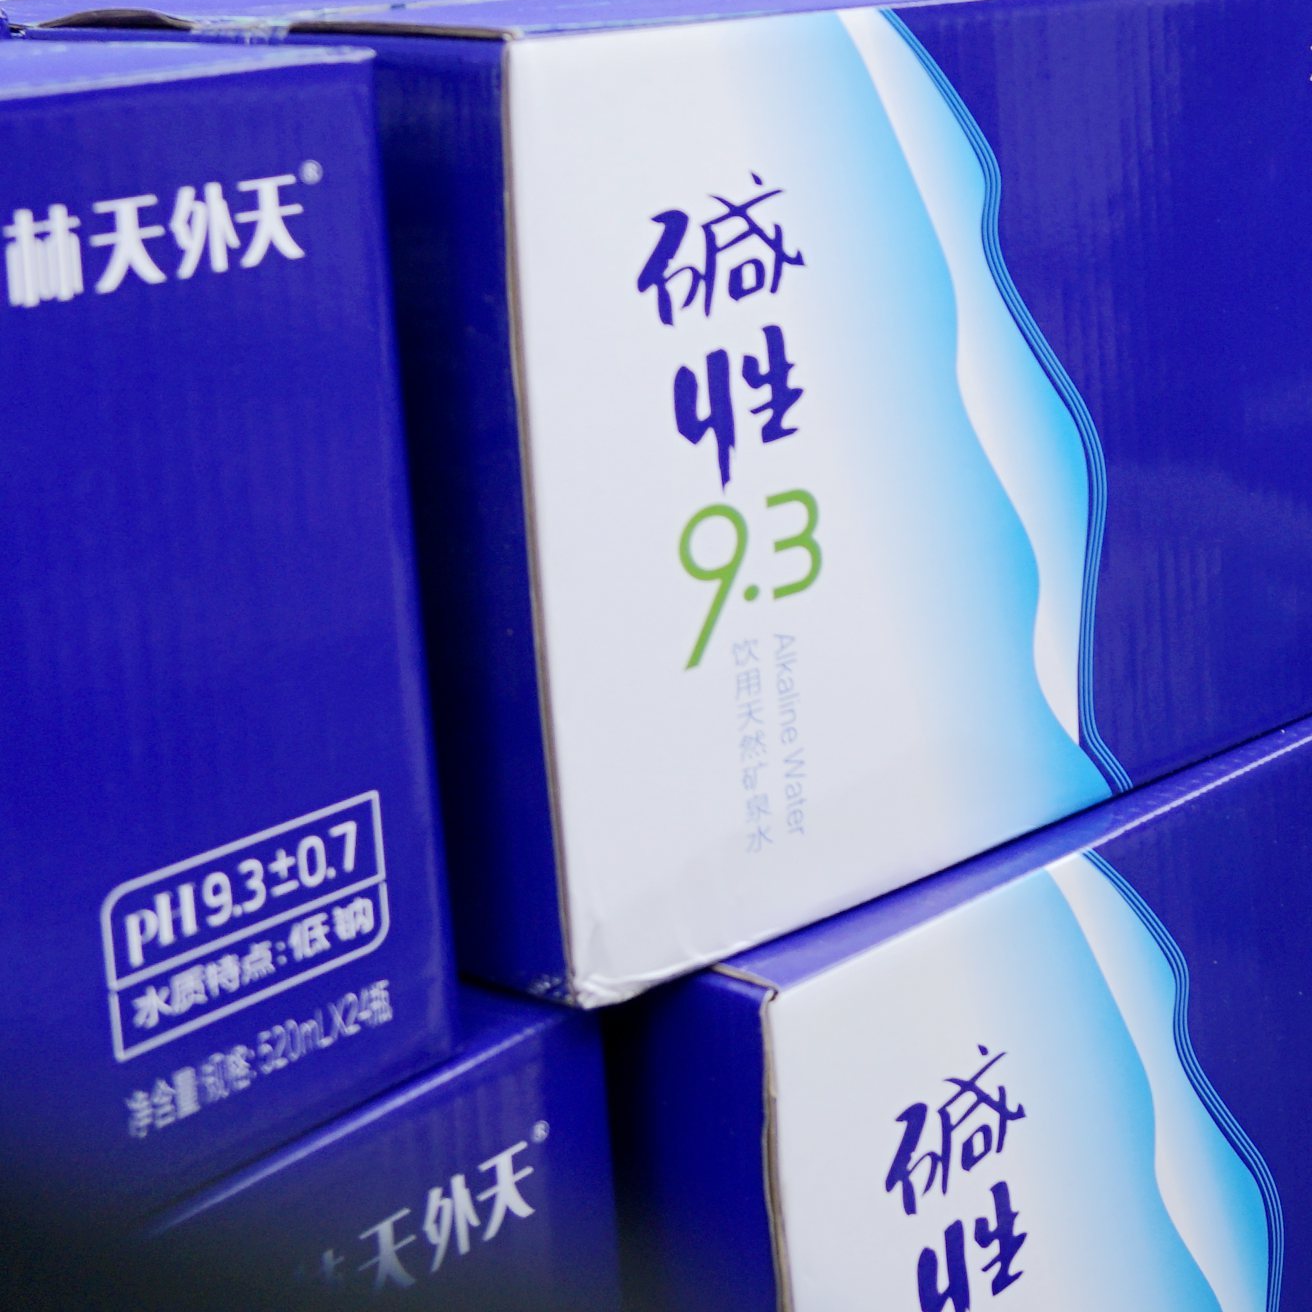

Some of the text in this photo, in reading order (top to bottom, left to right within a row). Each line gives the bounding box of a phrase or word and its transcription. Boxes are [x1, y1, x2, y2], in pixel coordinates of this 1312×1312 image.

[3, 174, 305, 308] 林天外天
[637, 171, 806, 494] 碱性
[678, 488, 823, 672] 9.3
[773, 634, 807, 835] Alkaline Water
[297, 1140, 536, 1290] 天外天
[885, 1043, 1028, 1312] 碱性
